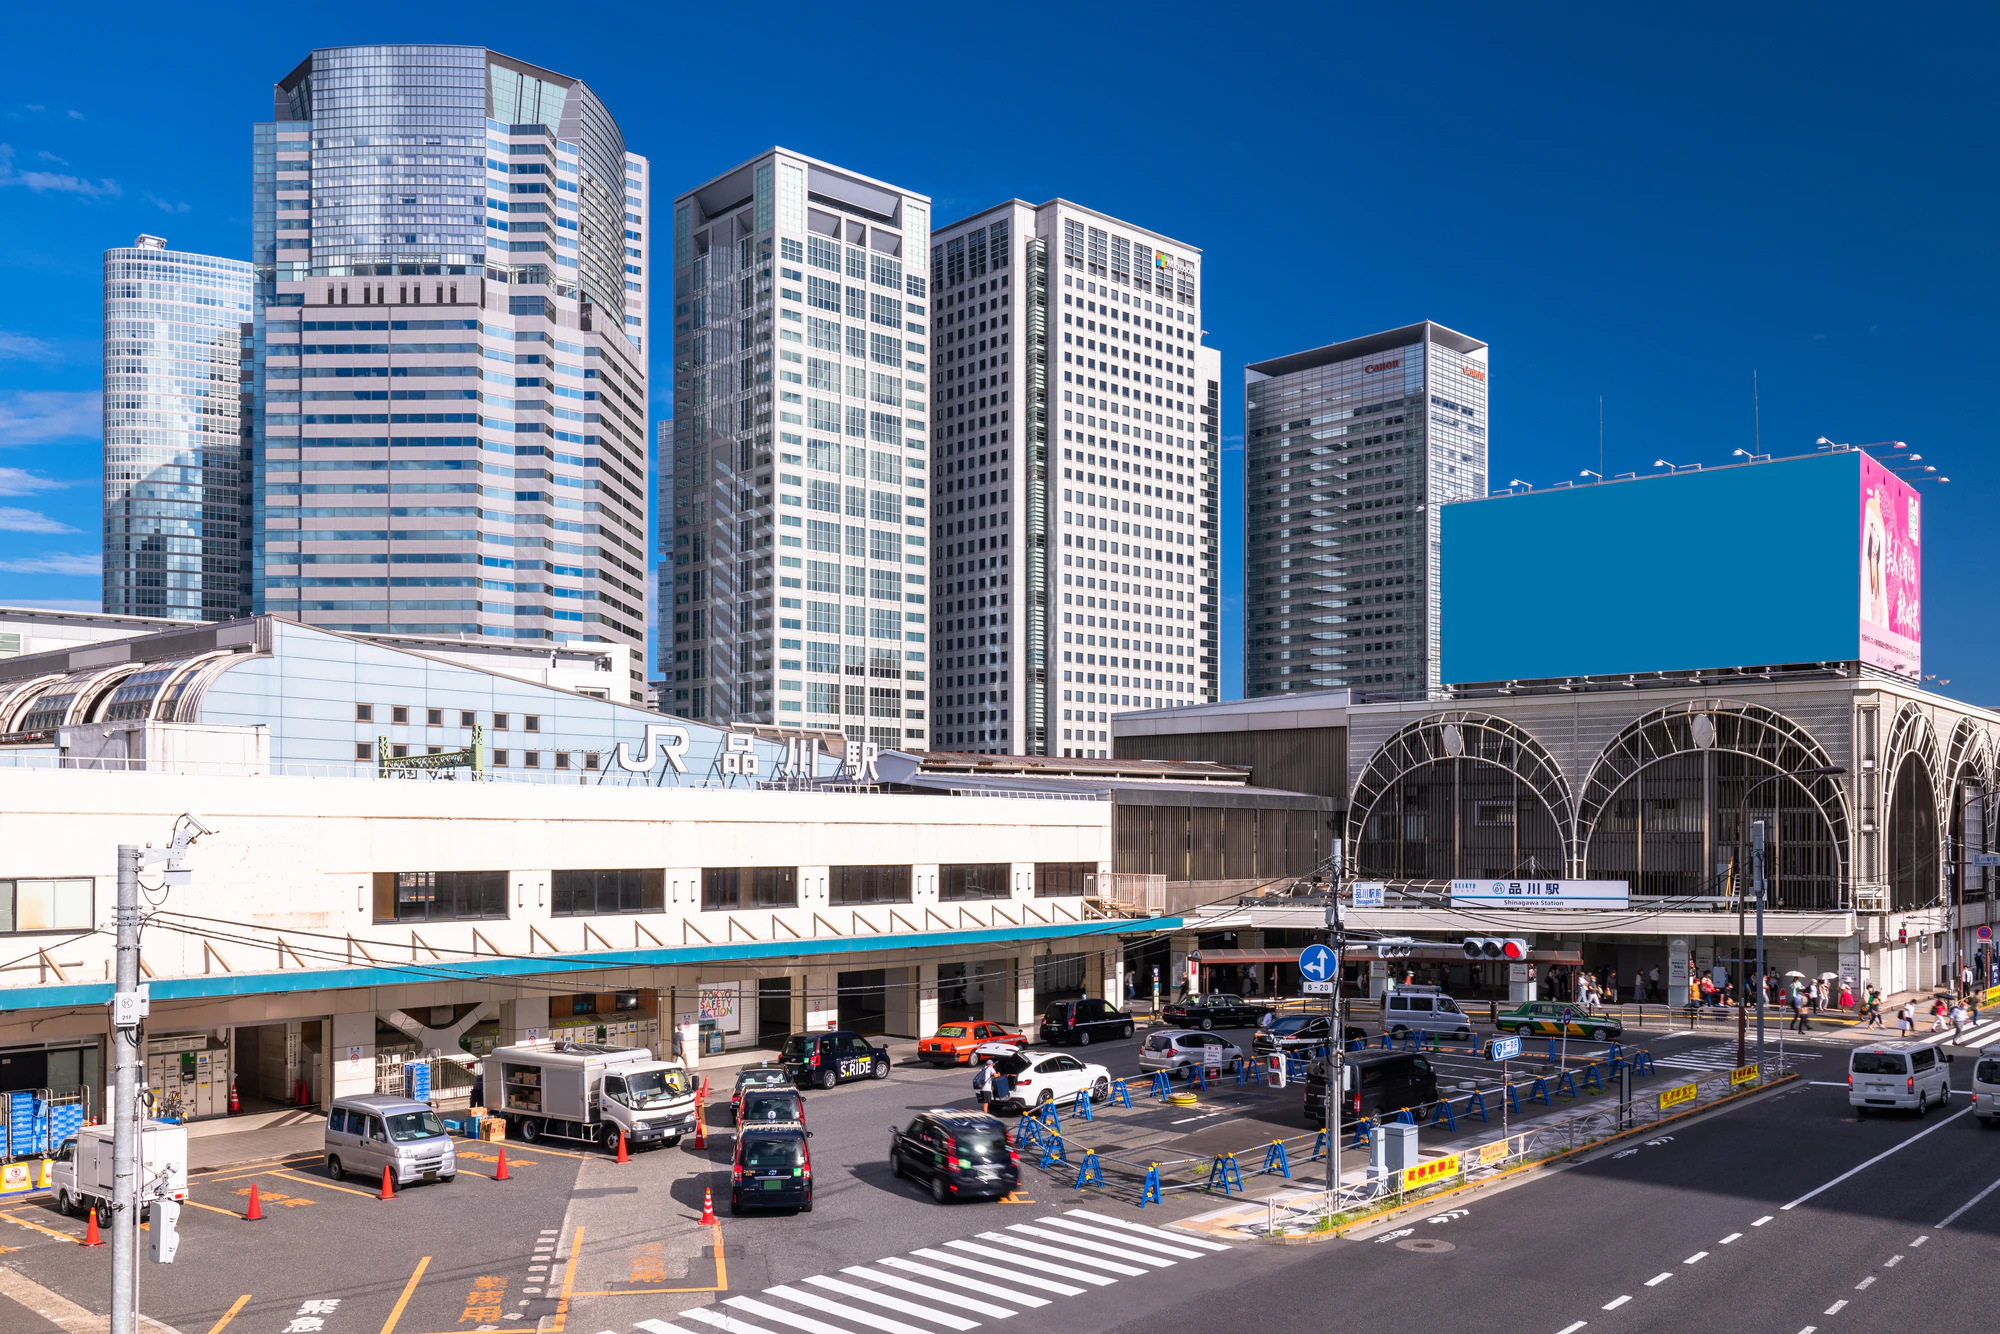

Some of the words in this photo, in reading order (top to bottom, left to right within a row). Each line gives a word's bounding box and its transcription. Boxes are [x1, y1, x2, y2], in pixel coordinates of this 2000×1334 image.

[1365, 359, 1399, 374] Canon
[1463, 366, 1485, 381] Canon
[617, 725, 690, 773] JR
[721, 733, 879, 781] 品川駅
[1356, 888, 1382, 899] 品川駅前
[1508, 883, 1560, 895] 品川駅
[1504, 899, 1539, 907] Shinagawa
[702, 989, 733, 1000] TOKYO
[700, 999, 732, 1009] SAFETY
[701, 1006, 733, 1017] ACTION
[841, 1061, 871, 1078] S.RIDE
[282, 1299, 341, 1333] 緊急
